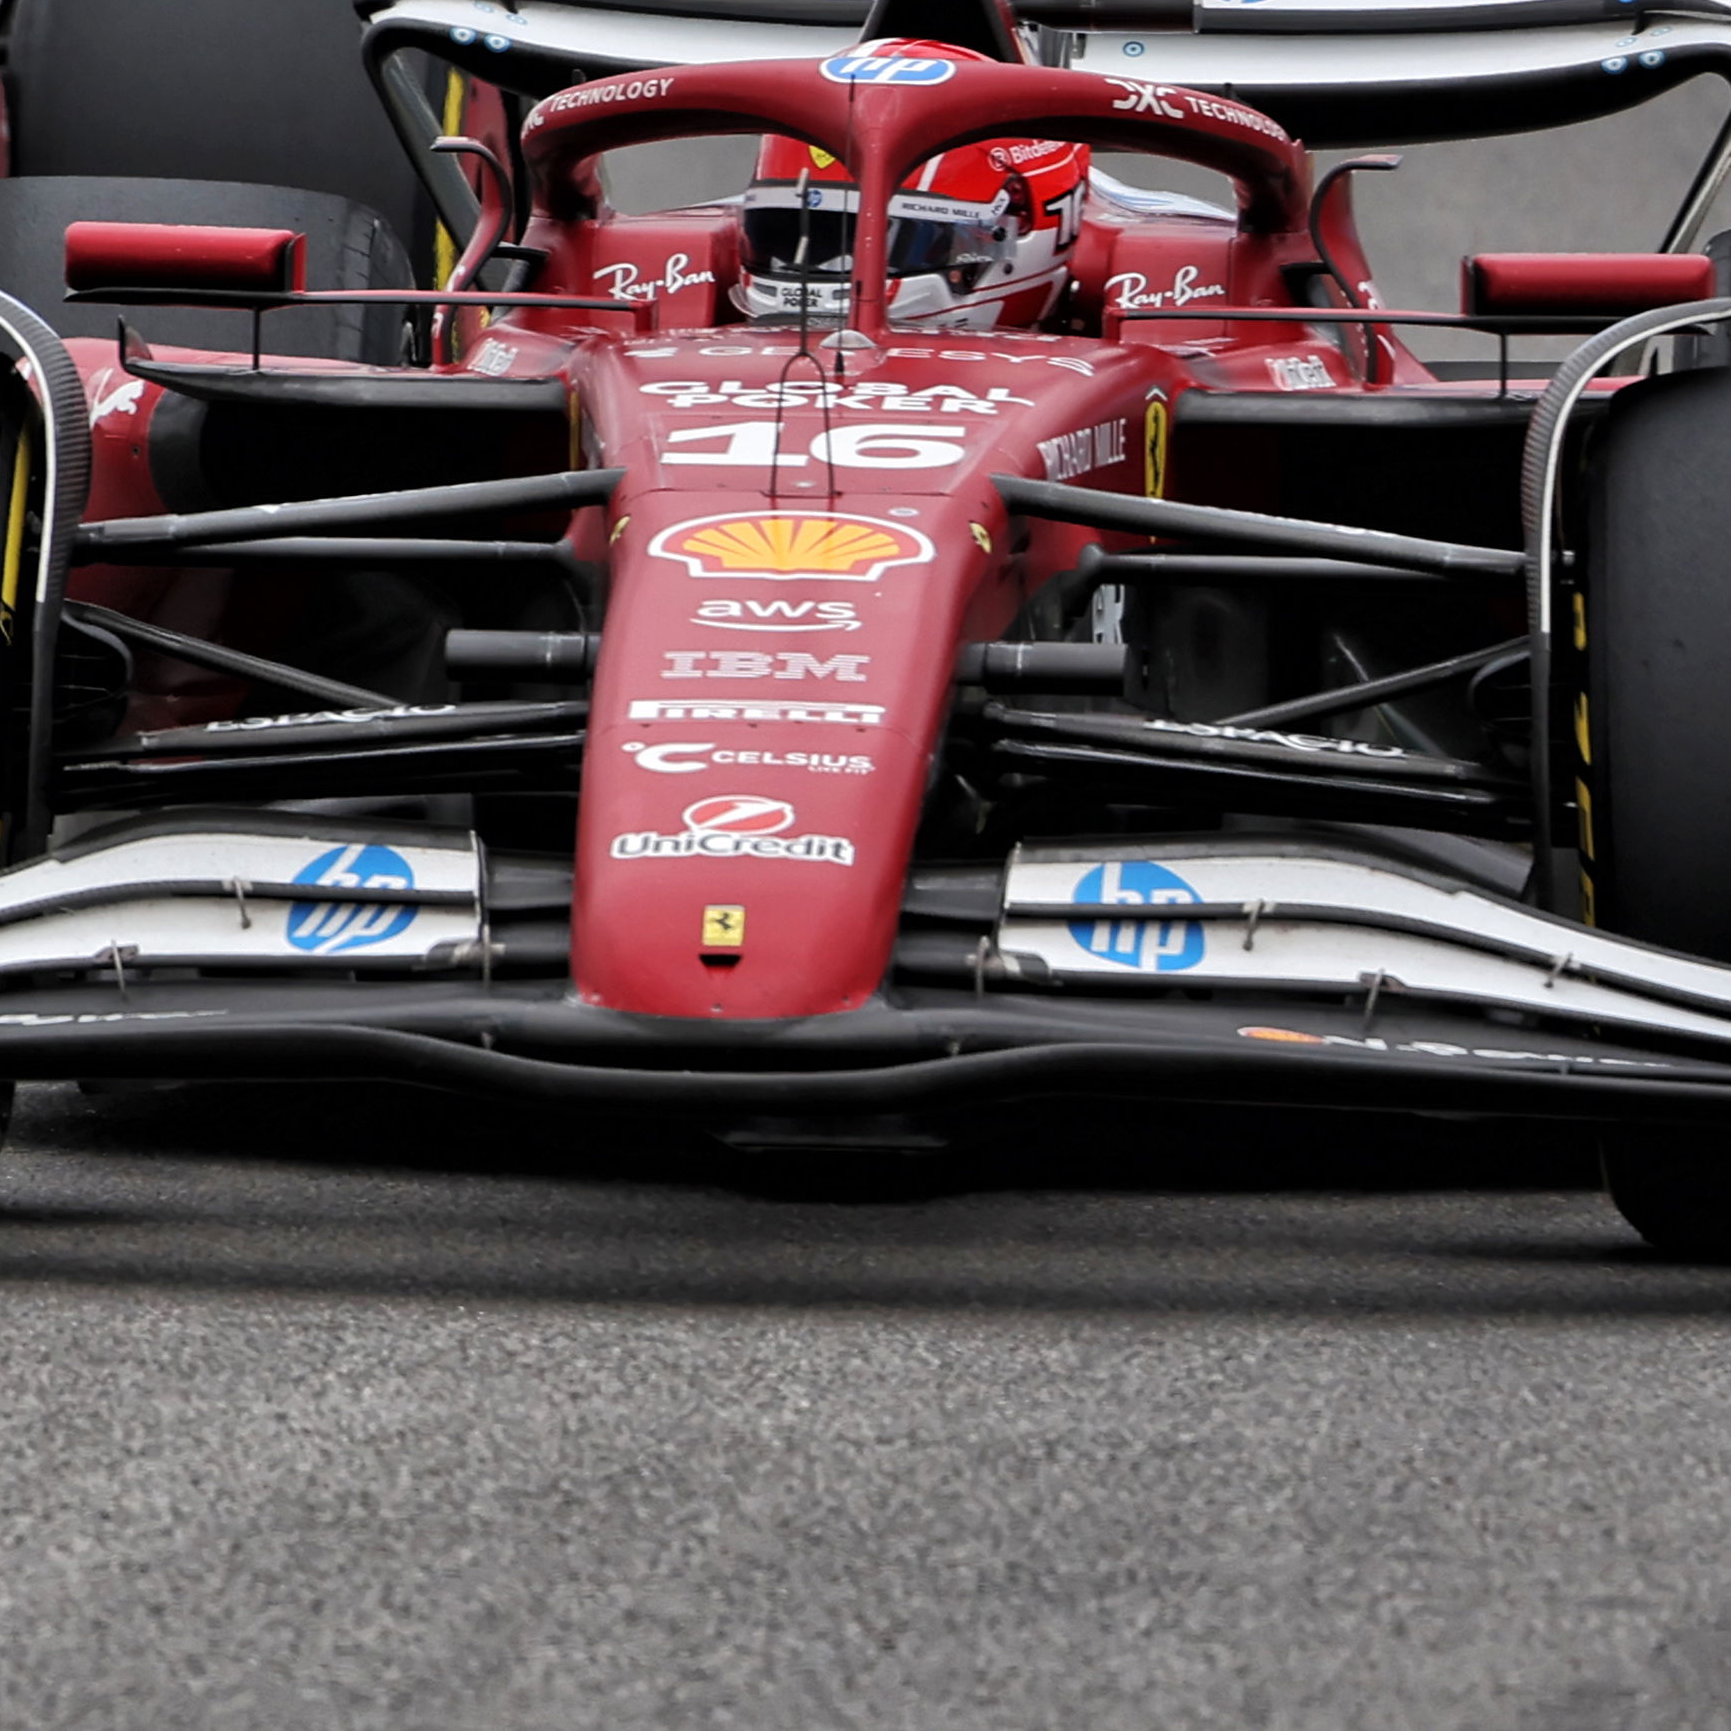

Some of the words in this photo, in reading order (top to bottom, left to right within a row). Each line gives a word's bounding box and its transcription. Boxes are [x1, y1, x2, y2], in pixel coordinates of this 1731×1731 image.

[549, 78, 675, 113] TECHNOLOGY
[1104, 78, 1184, 119] DXC
[593, 253, 716, 301] Ray-Ban
[1104, 266, 1226, 310] Ray-Ban
[781, 287, 823, 299] GLOAL
[783, 297, 819, 308] POER
[699, 346, 1094, 377] GEESYS
[639, 380, 1036, 407] GLOBAL
[667, 393, 1000, 415] POKER
[660, 421, 967, 469] 16
[660, 651, 871, 681] IBM
[627, 699, 887, 724] PIRELLI
[711, 750, 871, 769] CELSIUS
[617, 834, 850, 862] UniCredit
[292, 844, 409, 954] hp
[1090, 861, 1194, 972] hp
